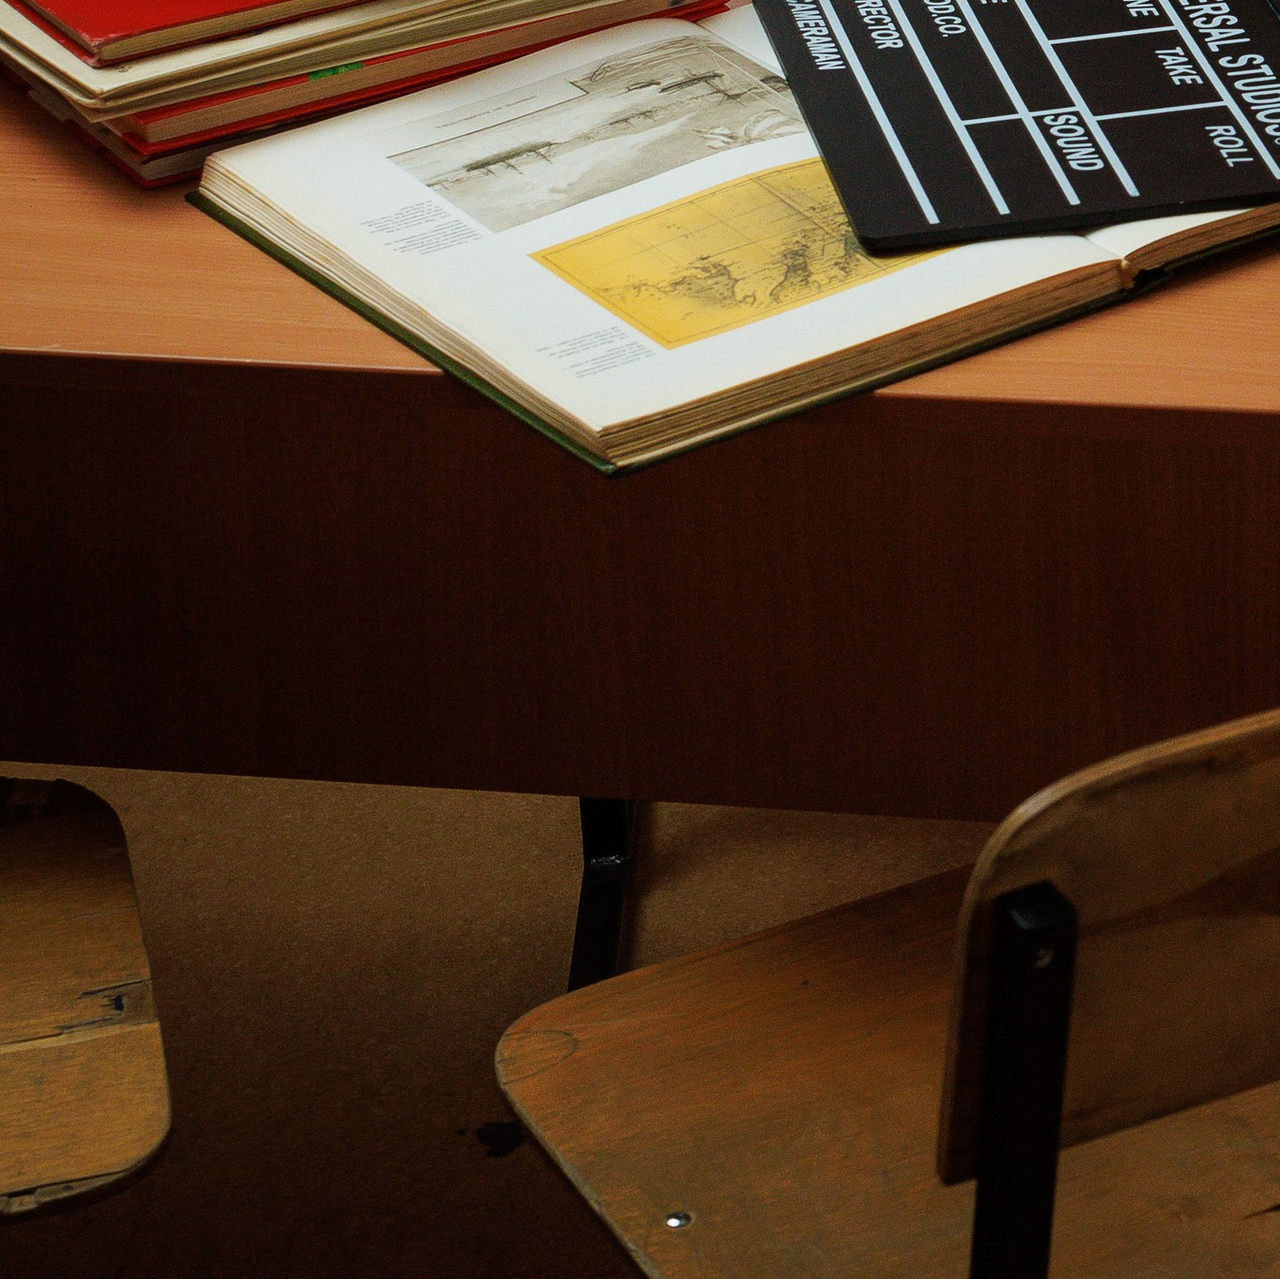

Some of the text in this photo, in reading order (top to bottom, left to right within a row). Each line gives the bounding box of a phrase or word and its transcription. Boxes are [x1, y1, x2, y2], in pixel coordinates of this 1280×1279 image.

[1154, 46, 1204, 86] TAKE
[1043, 114, 1105, 171] SOUND
[1204, 125, 1254, 168] ROLL
